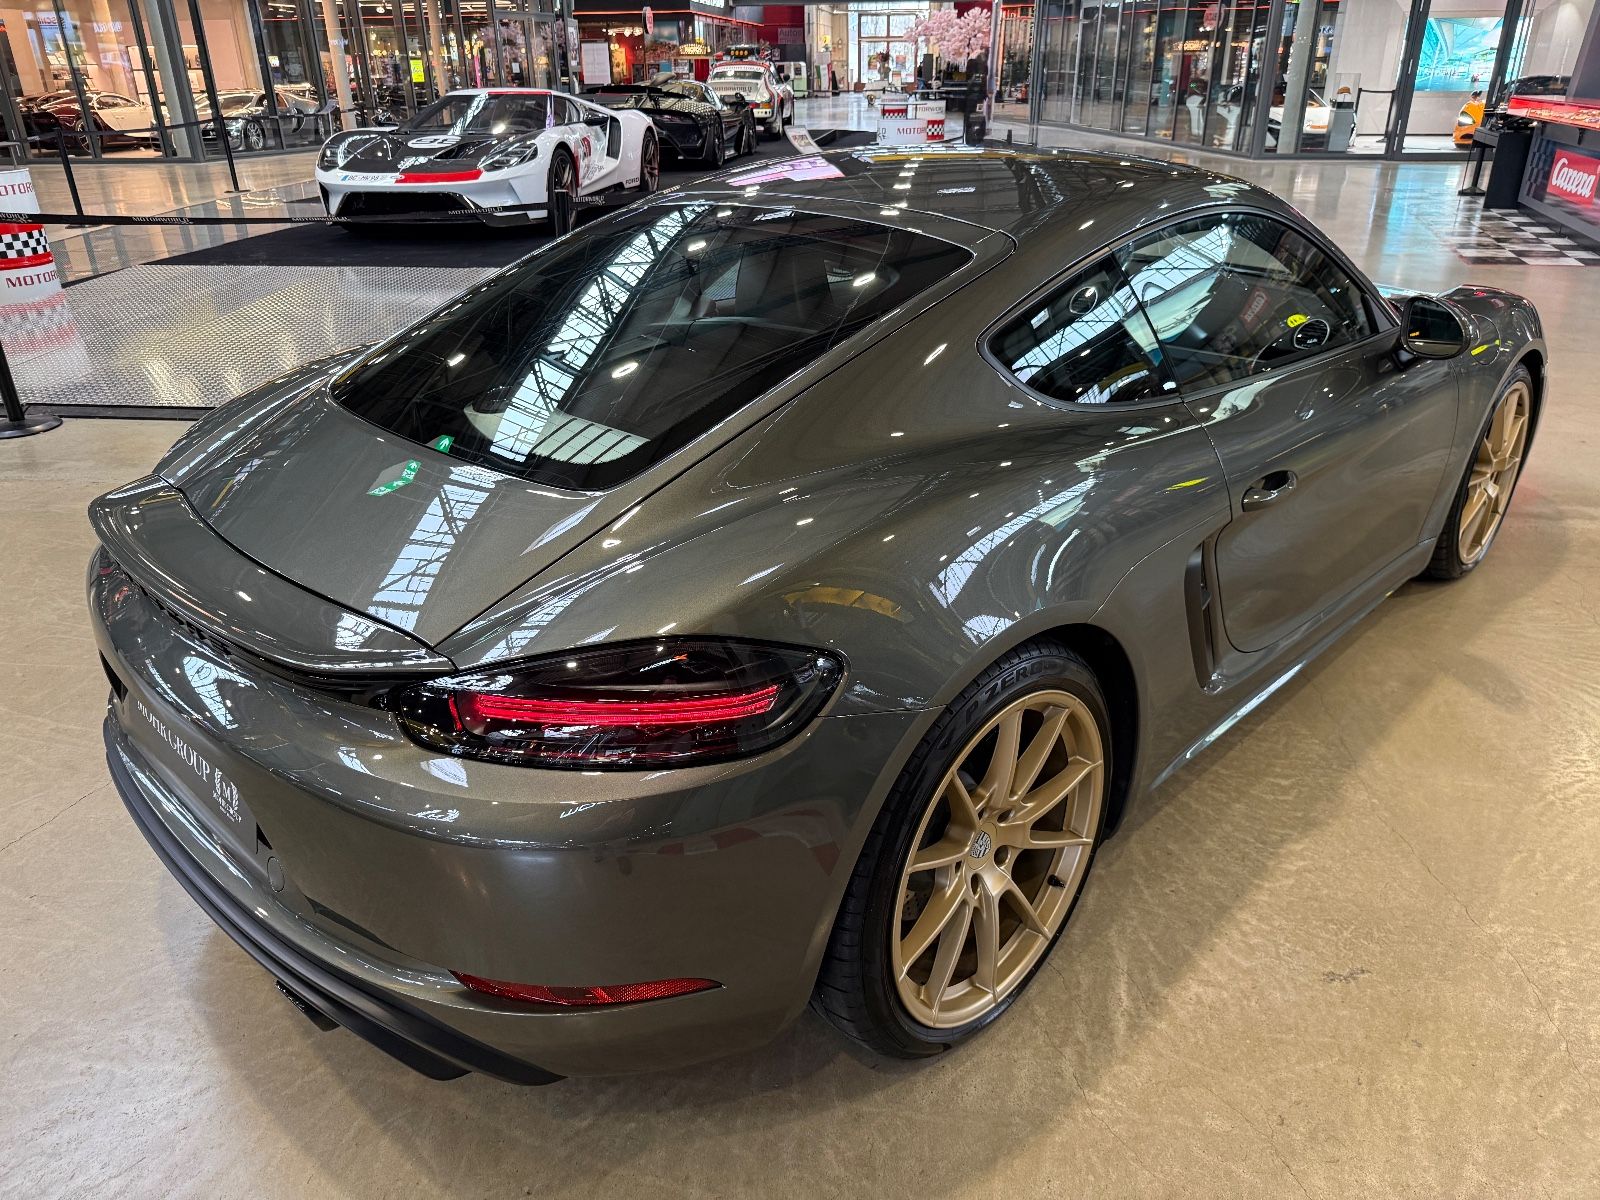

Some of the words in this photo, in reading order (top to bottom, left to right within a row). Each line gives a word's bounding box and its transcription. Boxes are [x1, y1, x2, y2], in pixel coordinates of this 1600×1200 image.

[1551, 157, 1596, 198] Carrera
[448, 206, 503, 215] MOTORWORLD
[168, 729, 211, 783] GROUP
